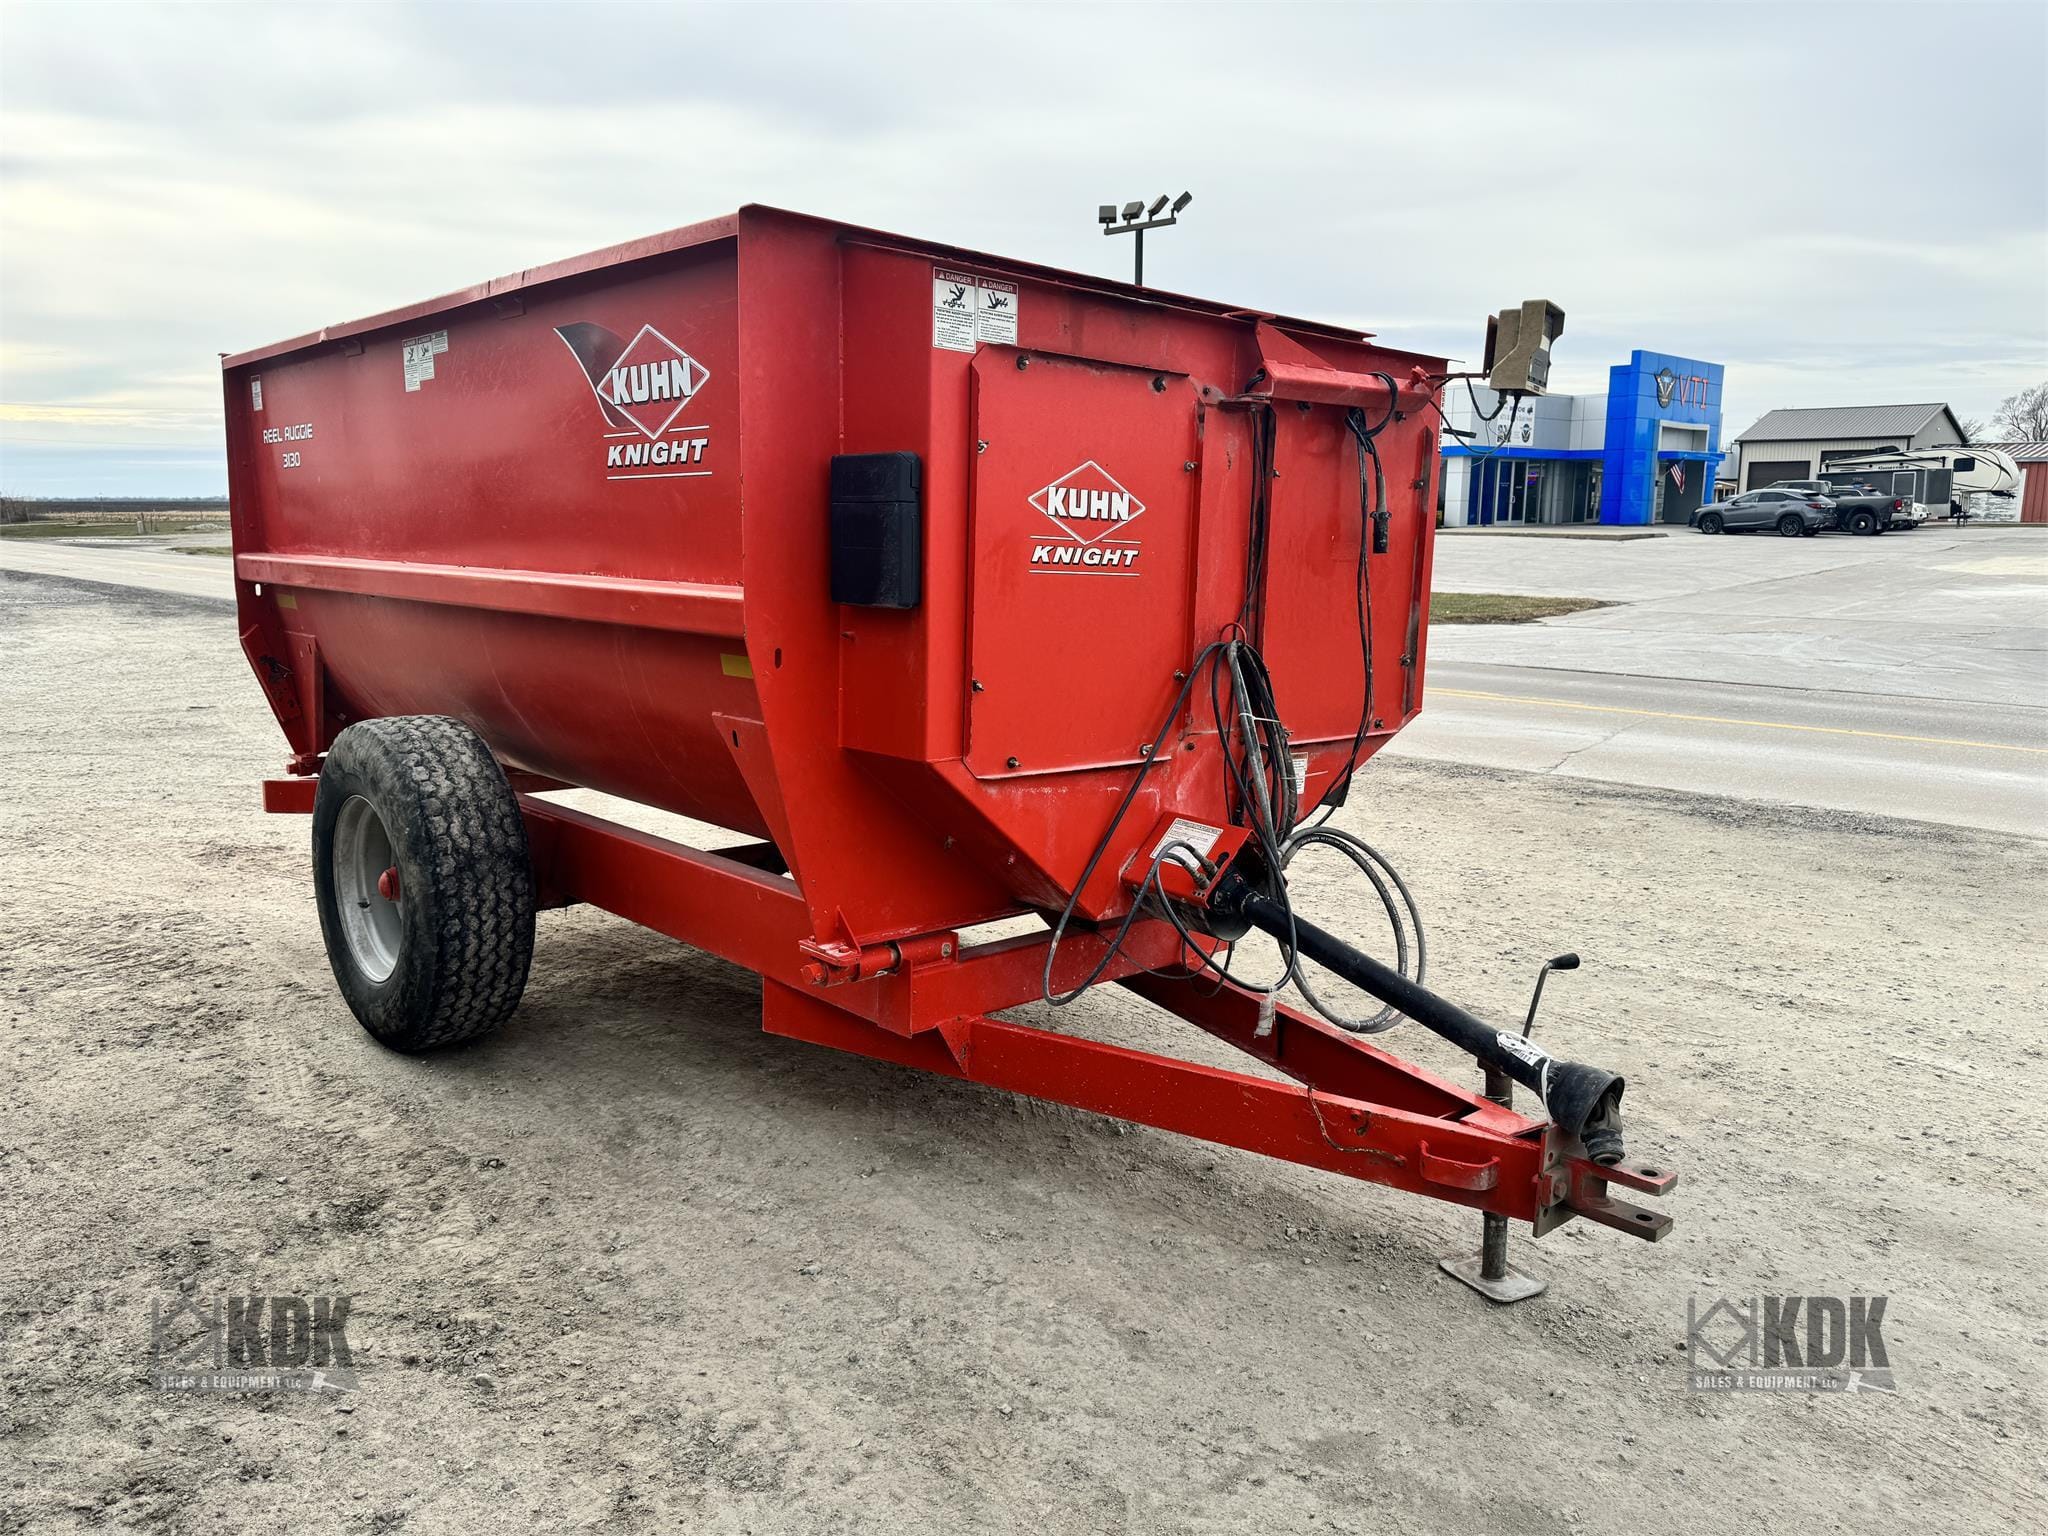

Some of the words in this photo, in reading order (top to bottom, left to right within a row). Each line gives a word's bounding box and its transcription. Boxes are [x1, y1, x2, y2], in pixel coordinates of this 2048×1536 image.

[946, 272, 972, 285] DANGER
[988, 281, 1013, 293] DANGER
[611, 357, 692, 405] KUHN
[1679, 374, 1709, 410] VTI
[263, 428, 283, 444] REEL
[284, 423, 313, 441] AUGGIE
[282, 452, 301, 468] 3130
[607, 438, 709, 468] KNIGHT
[1047, 485, 1130, 522] KUHN
[1030, 544, 1139, 568] KNIGHT
